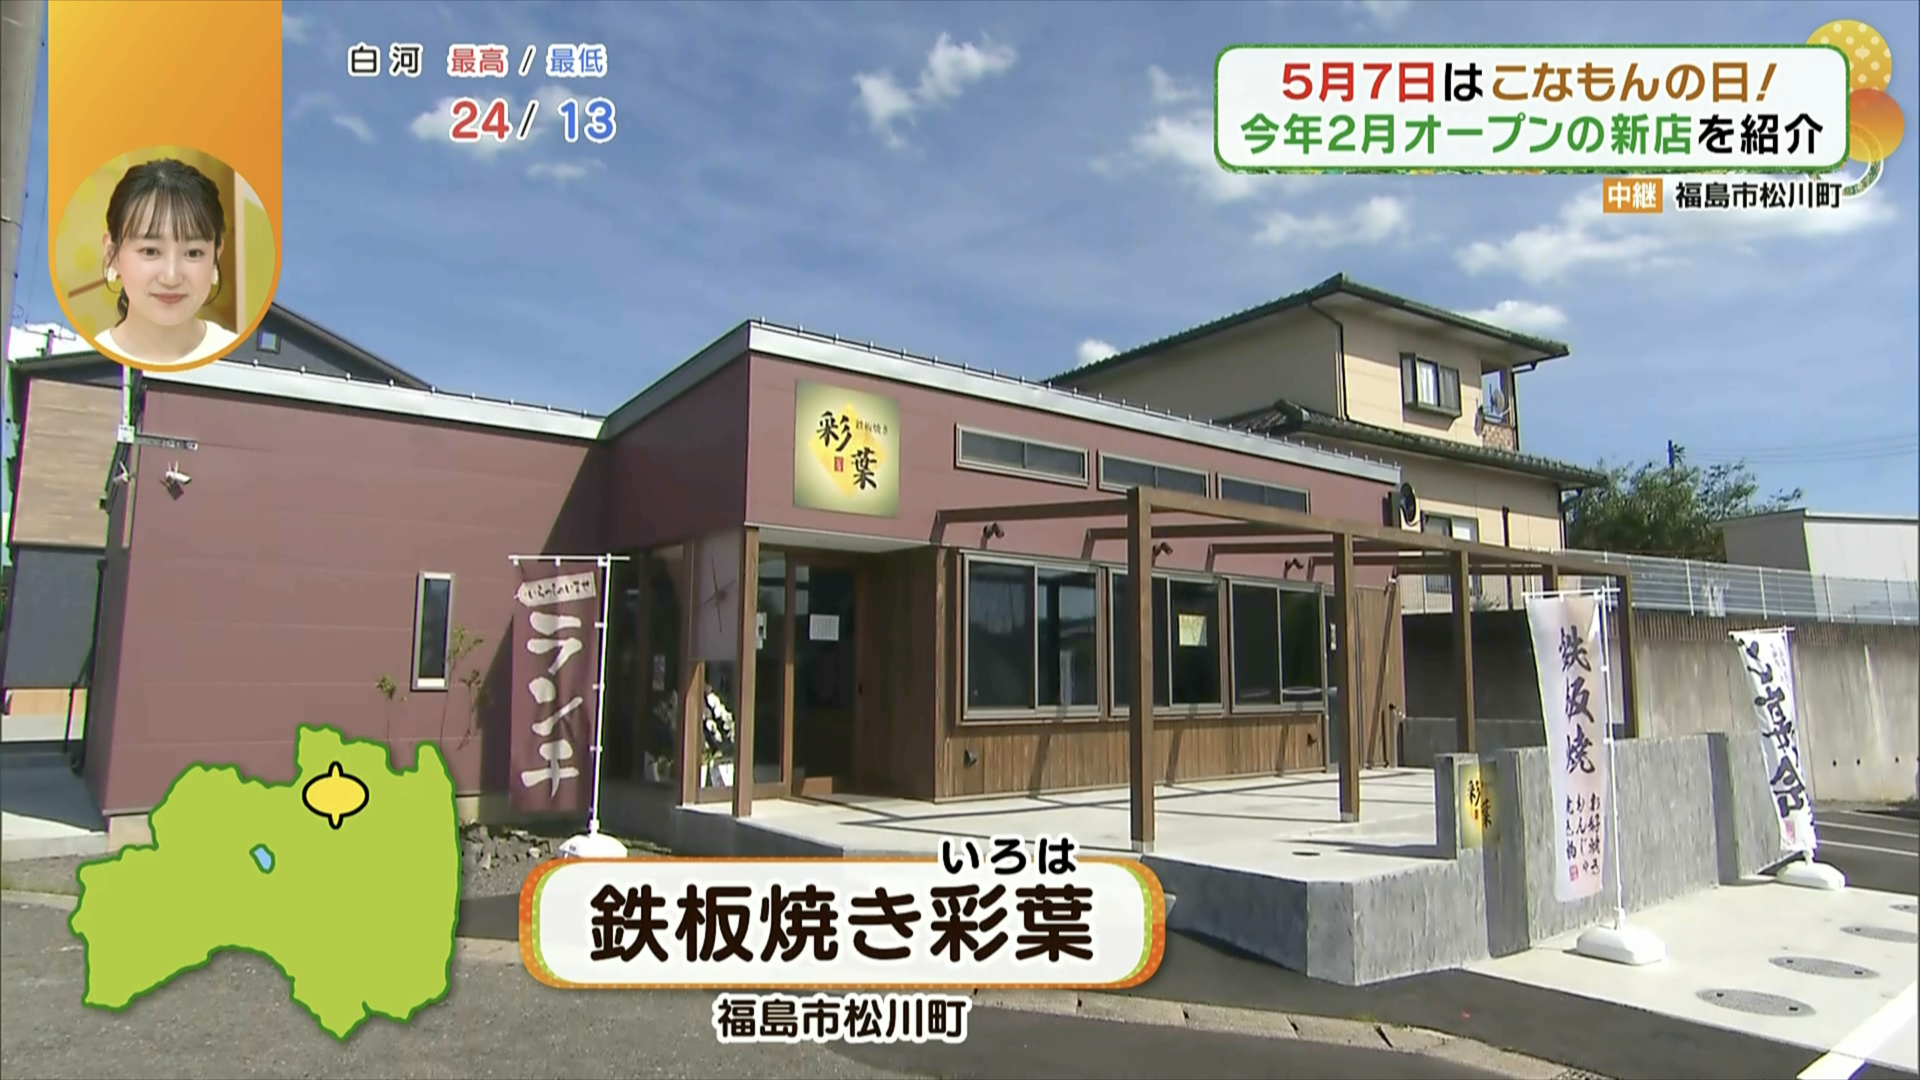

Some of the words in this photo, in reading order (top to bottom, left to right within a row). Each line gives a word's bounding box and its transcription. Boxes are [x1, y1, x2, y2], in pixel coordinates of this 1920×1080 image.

[816, 410, 878, 491] 彩葉
[519, 610, 583, 799] ランチ
[1558, 624, 1597, 775] 鉄板焼
[1467, 779, 1493, 830] 彩葉
